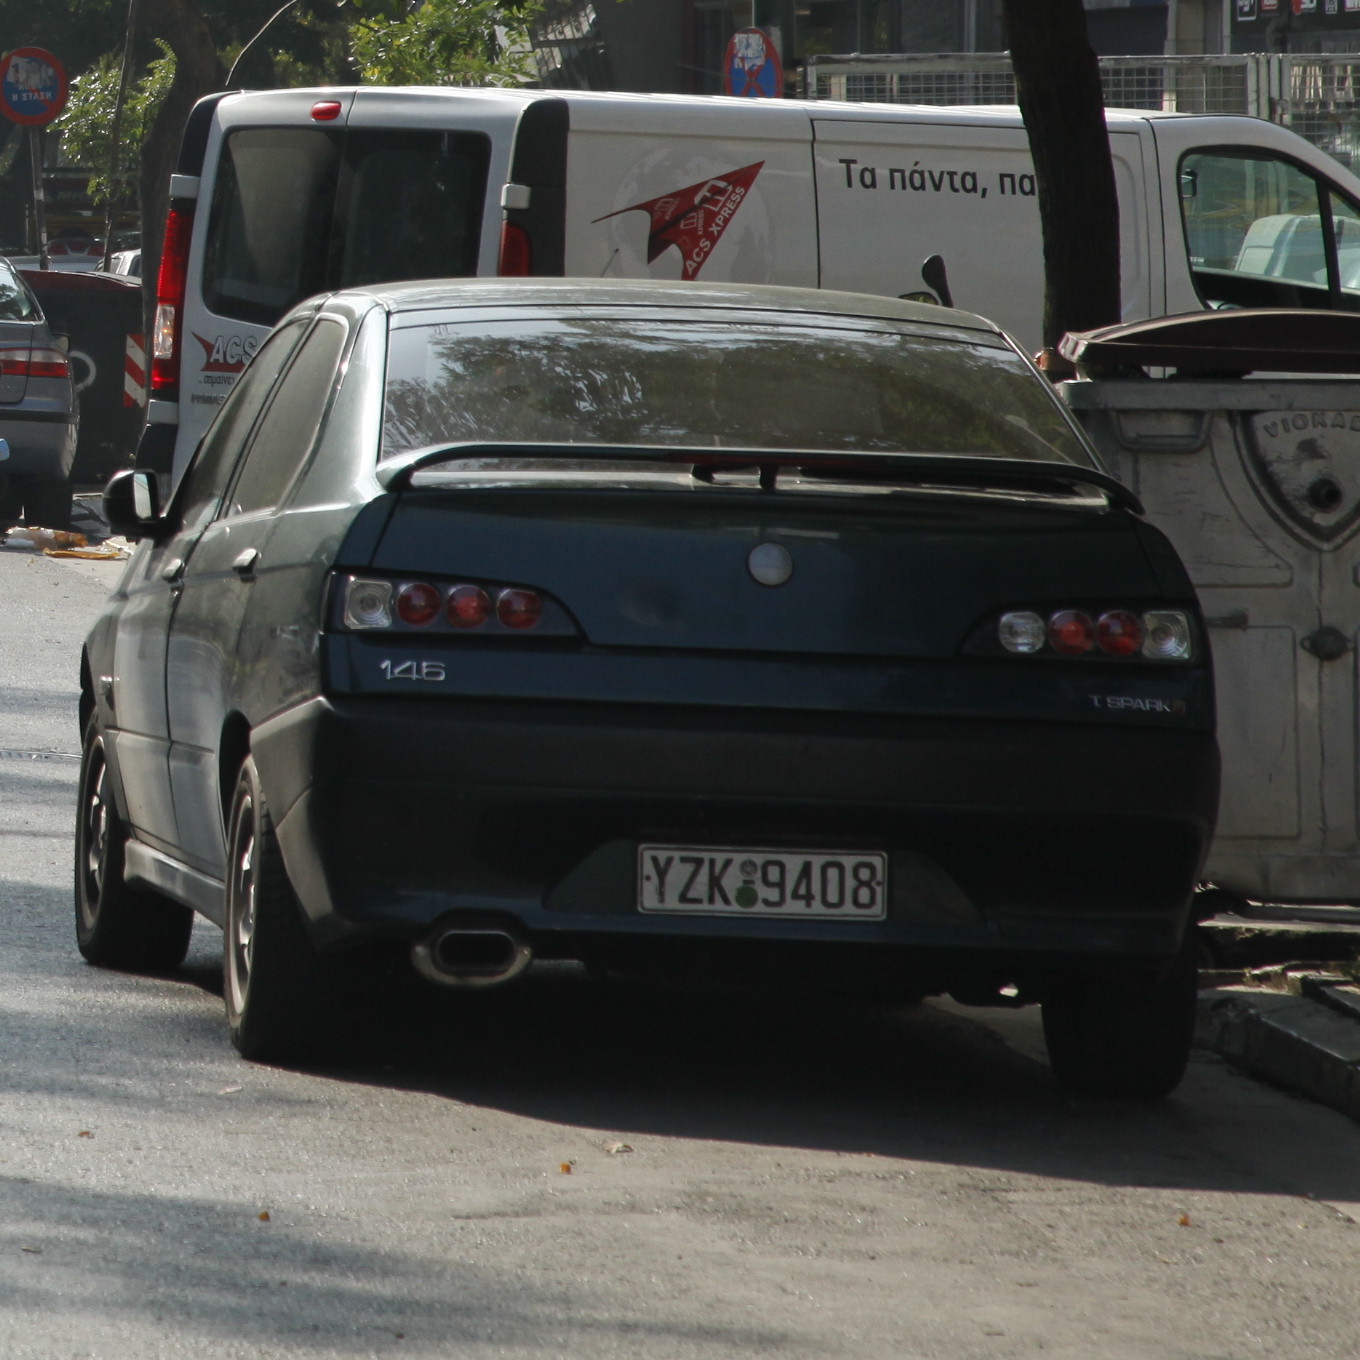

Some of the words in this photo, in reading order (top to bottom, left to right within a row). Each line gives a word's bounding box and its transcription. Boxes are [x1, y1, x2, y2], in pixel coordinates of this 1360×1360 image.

[838, 158, 878, 190] Τα
[888, 161, 988, 199] πάντα,
[998, 172, 1038, 197] πα
[708, 186, 746, 237] XPRESS
[1107, 696, 1172, 713] SPARK
